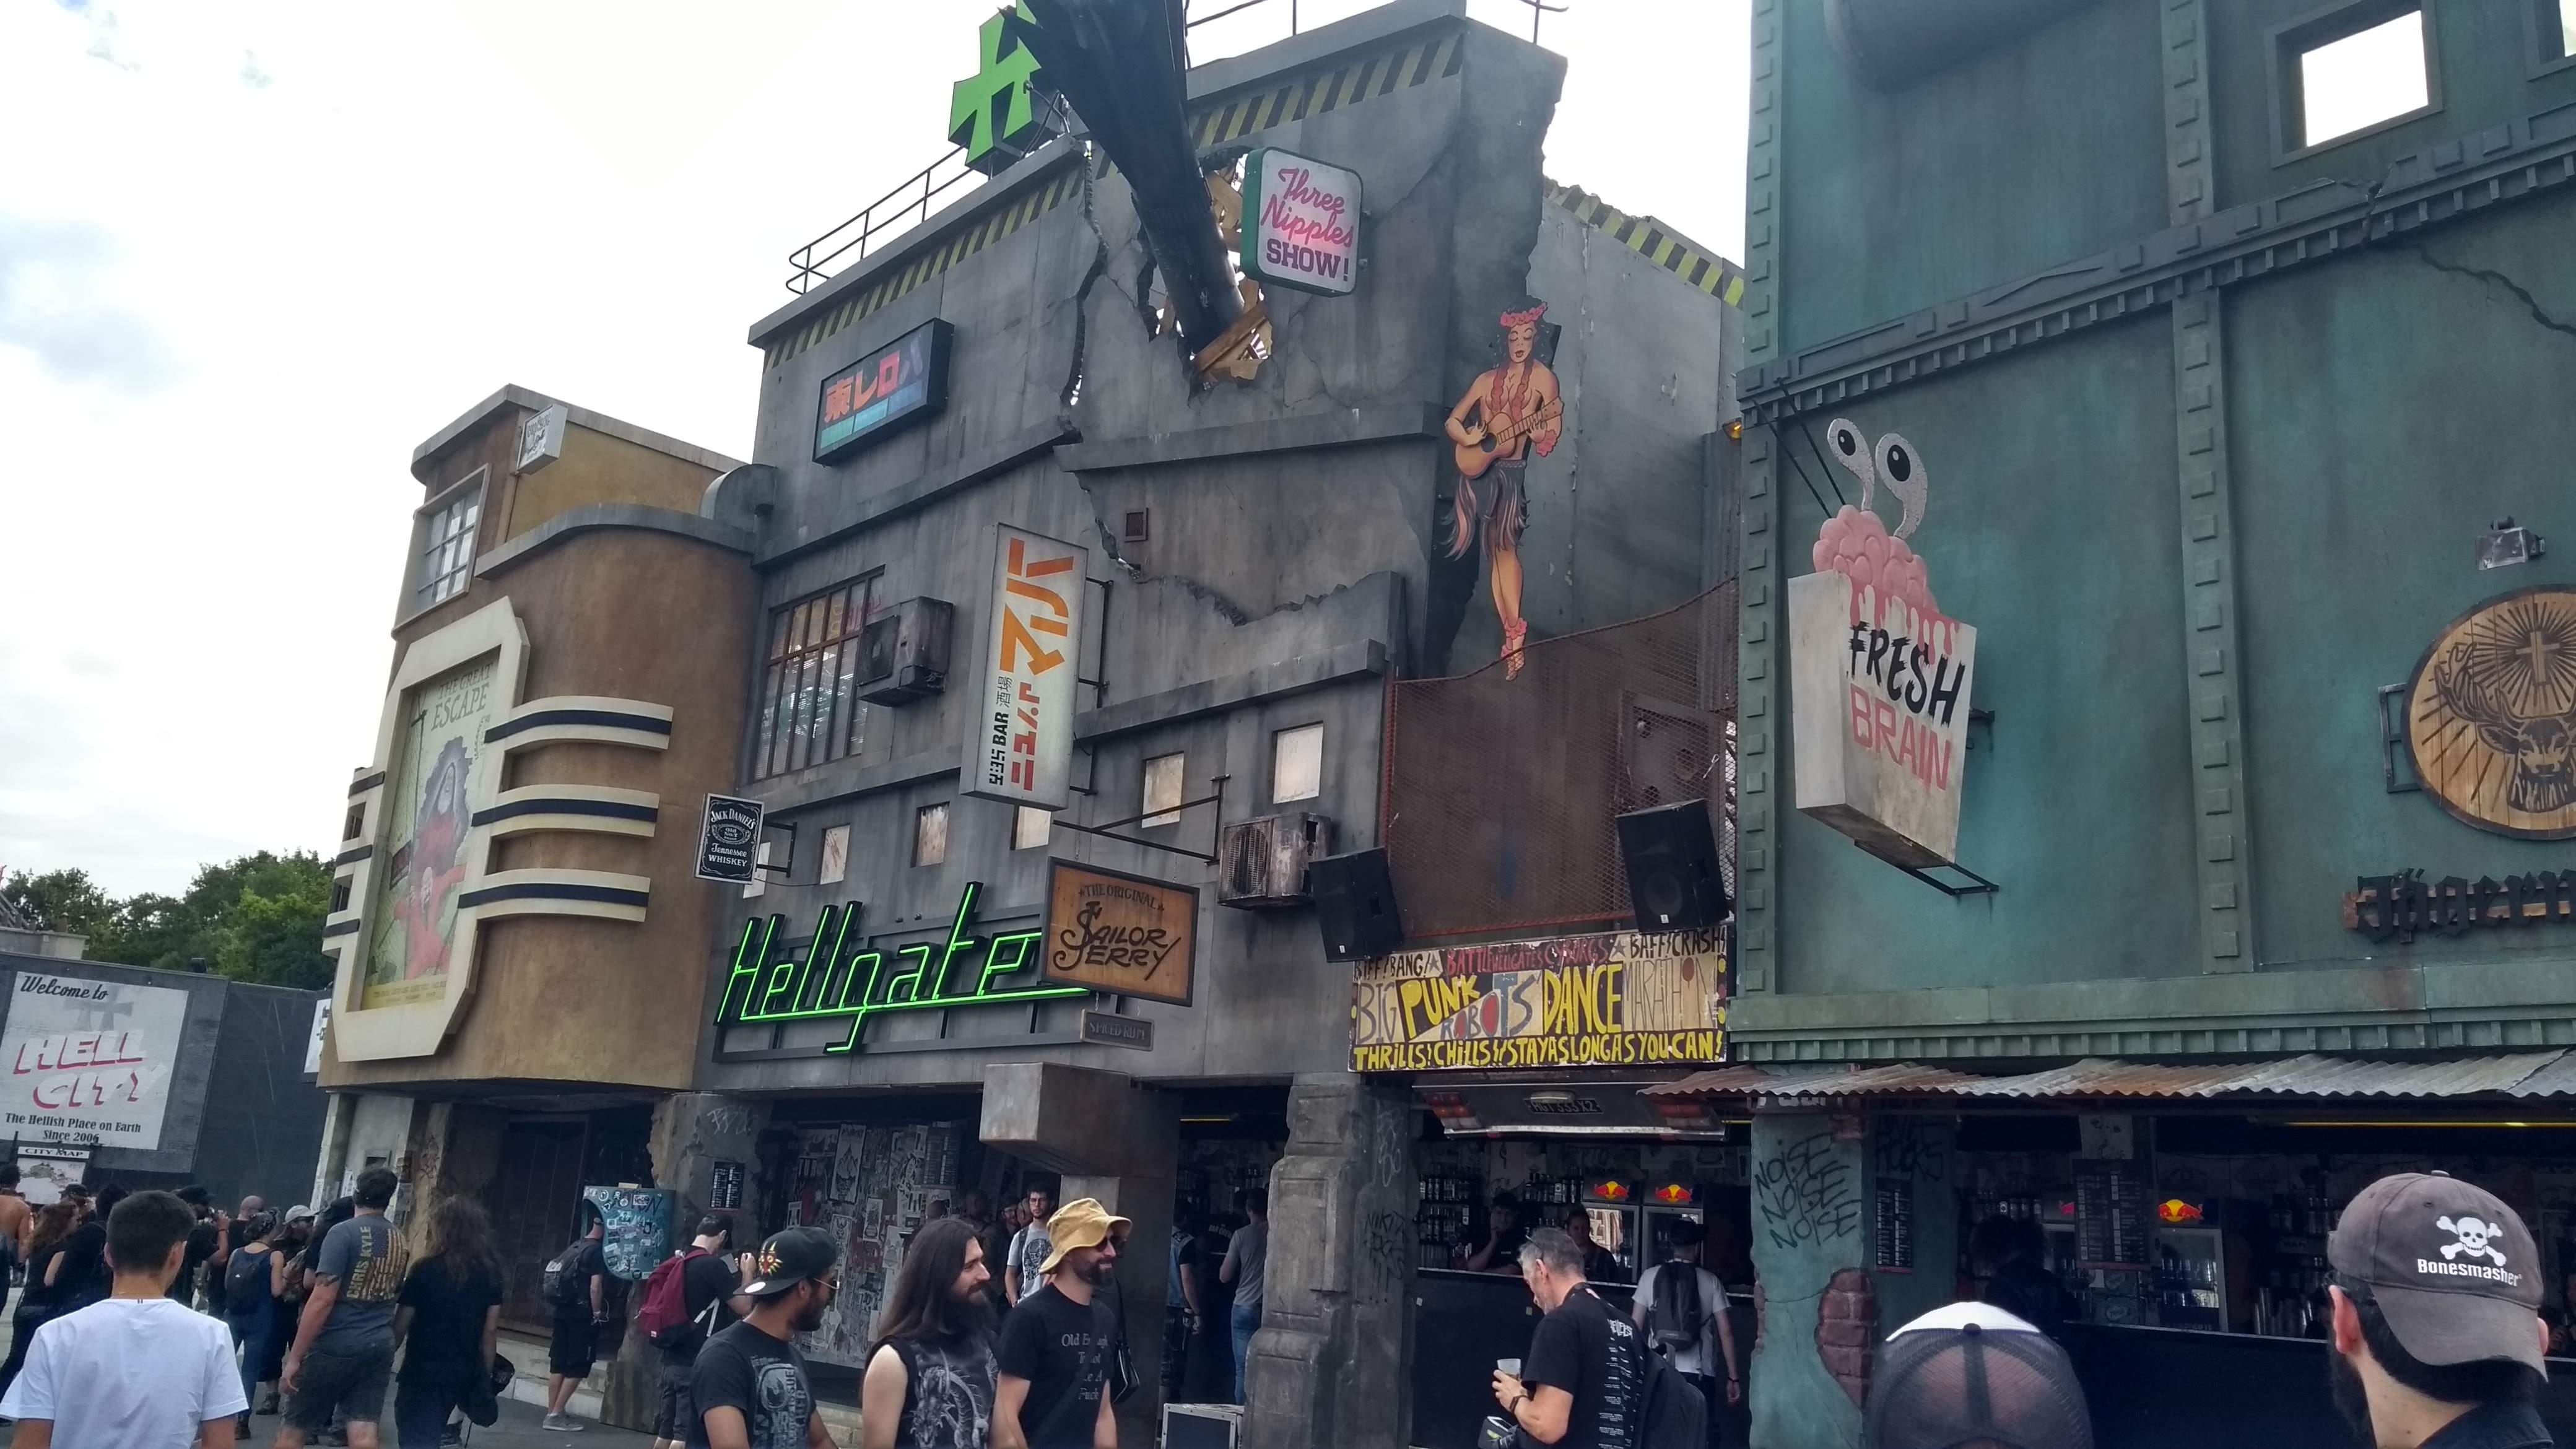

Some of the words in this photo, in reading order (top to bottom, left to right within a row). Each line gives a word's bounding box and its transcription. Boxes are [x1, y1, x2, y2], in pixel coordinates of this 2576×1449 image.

[1277, 167, 1345, 215] Three
[1260, 193, 1354, 248] Nipples
[438, 679, 459, 700] THE
[458, 661, 494, 690] GREAT
[1848, 620, 1966, 727] FRESH
[431, 682, 490, 731] ESCAPE
[993, 711, 1009, 747] BAR
[1850, 682, 1952, 792] BRAIN
[711, 810, 728, 823] JACK
[729, 808, 756, 830] DANIEL'S
[708, 854, 748, 867] WHISKEY
[711, 843, 747, 858] Tennessee
[1084, 884, 1105, 898] THE
[1107, 884, 1156, 910] ORIGINAL
[1060, 901, 1169, 951] SAILOR
[714, 881, 1043, 1054] Hellgate
[1053, 932, 1181, 981] JERRY
[1447, 946, 1492, 976] BATTLE
[20, 975, 90, 999] Welcome
[92, 984, 108, 1001] to
[1400, 974, 1481, 1040] PUNK
[1543, 963, 1624, 1035] DANCE
[1622, 957, 1718, 1032] MARATHON
[1090, 1022, 1122, 1037] SPICED
[1123, 1025, 1145, 1040] RUM
[1357, 981, 1397, 1045] BIG
[13, 1029, 147, 1074] HELL
[1507, 1037, 1549, 1066] STAY
[1549, 1036, 1570, 1064] AS
[1570, 1034, 1611, 1063] LONG
[1611, 1033, 1636, 1064] AS
[1637, 1032, 1670, 1061] YOU
[33, 1063, 168, 1109] CITY
[6, 1113, 26, 1125] The
[28, 1115, 65, 1128] Hellish
[67, 1118, 97, 1130] Place
[100, 1121, 112, 1131] on
[115, 1121, 141, 1133] Earth
[43, 1129, 71, 1142] Since
[72, 1132, 100, 1143] 2006
[25, 1147, 53, 1155] CITY
[55, 1149, 84, 1157] MAP
[1770, 1199, 1862, 1250] NOISE
[346, 1260, 370, 1299] CHRIS
[359, 1225, 373, 1258] KYLE
[2417, 1258, 2518, 1287] Bonesmasher
[1061, 1333, 1080, 1347] Old
